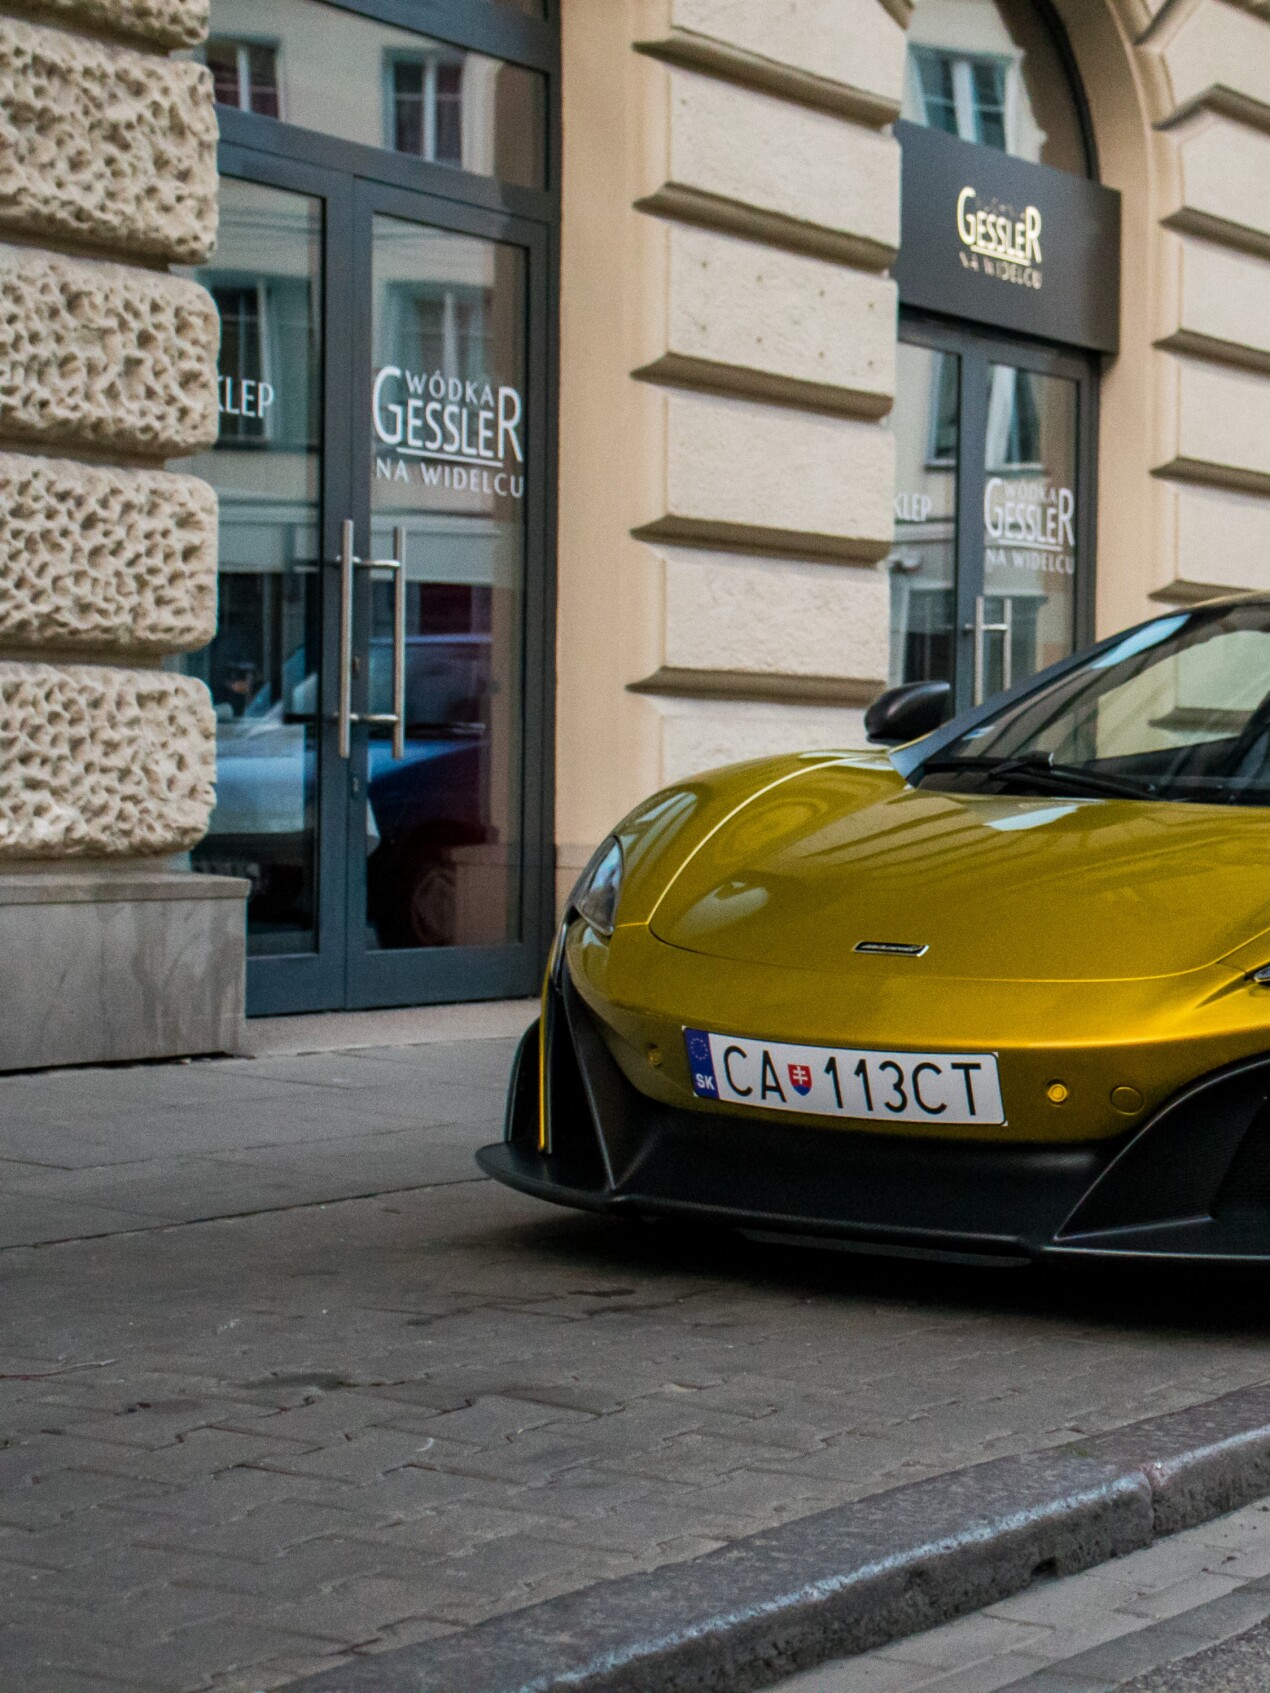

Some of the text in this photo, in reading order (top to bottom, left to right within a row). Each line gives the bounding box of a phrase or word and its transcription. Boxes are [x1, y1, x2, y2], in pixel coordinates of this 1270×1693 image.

[957, 186, 1042, 263] GESSLER
[373, 365, 524, 463] GESSLER
[406, 369, 495, 407] WÓDKA
[376, 456, 524, 498] NA WIDELCU
[984, 477, 1074, 547] GESSLER
[695, 1073, 716, 1091] SK
[723, 1045, 982, 1116] CA 113CT
